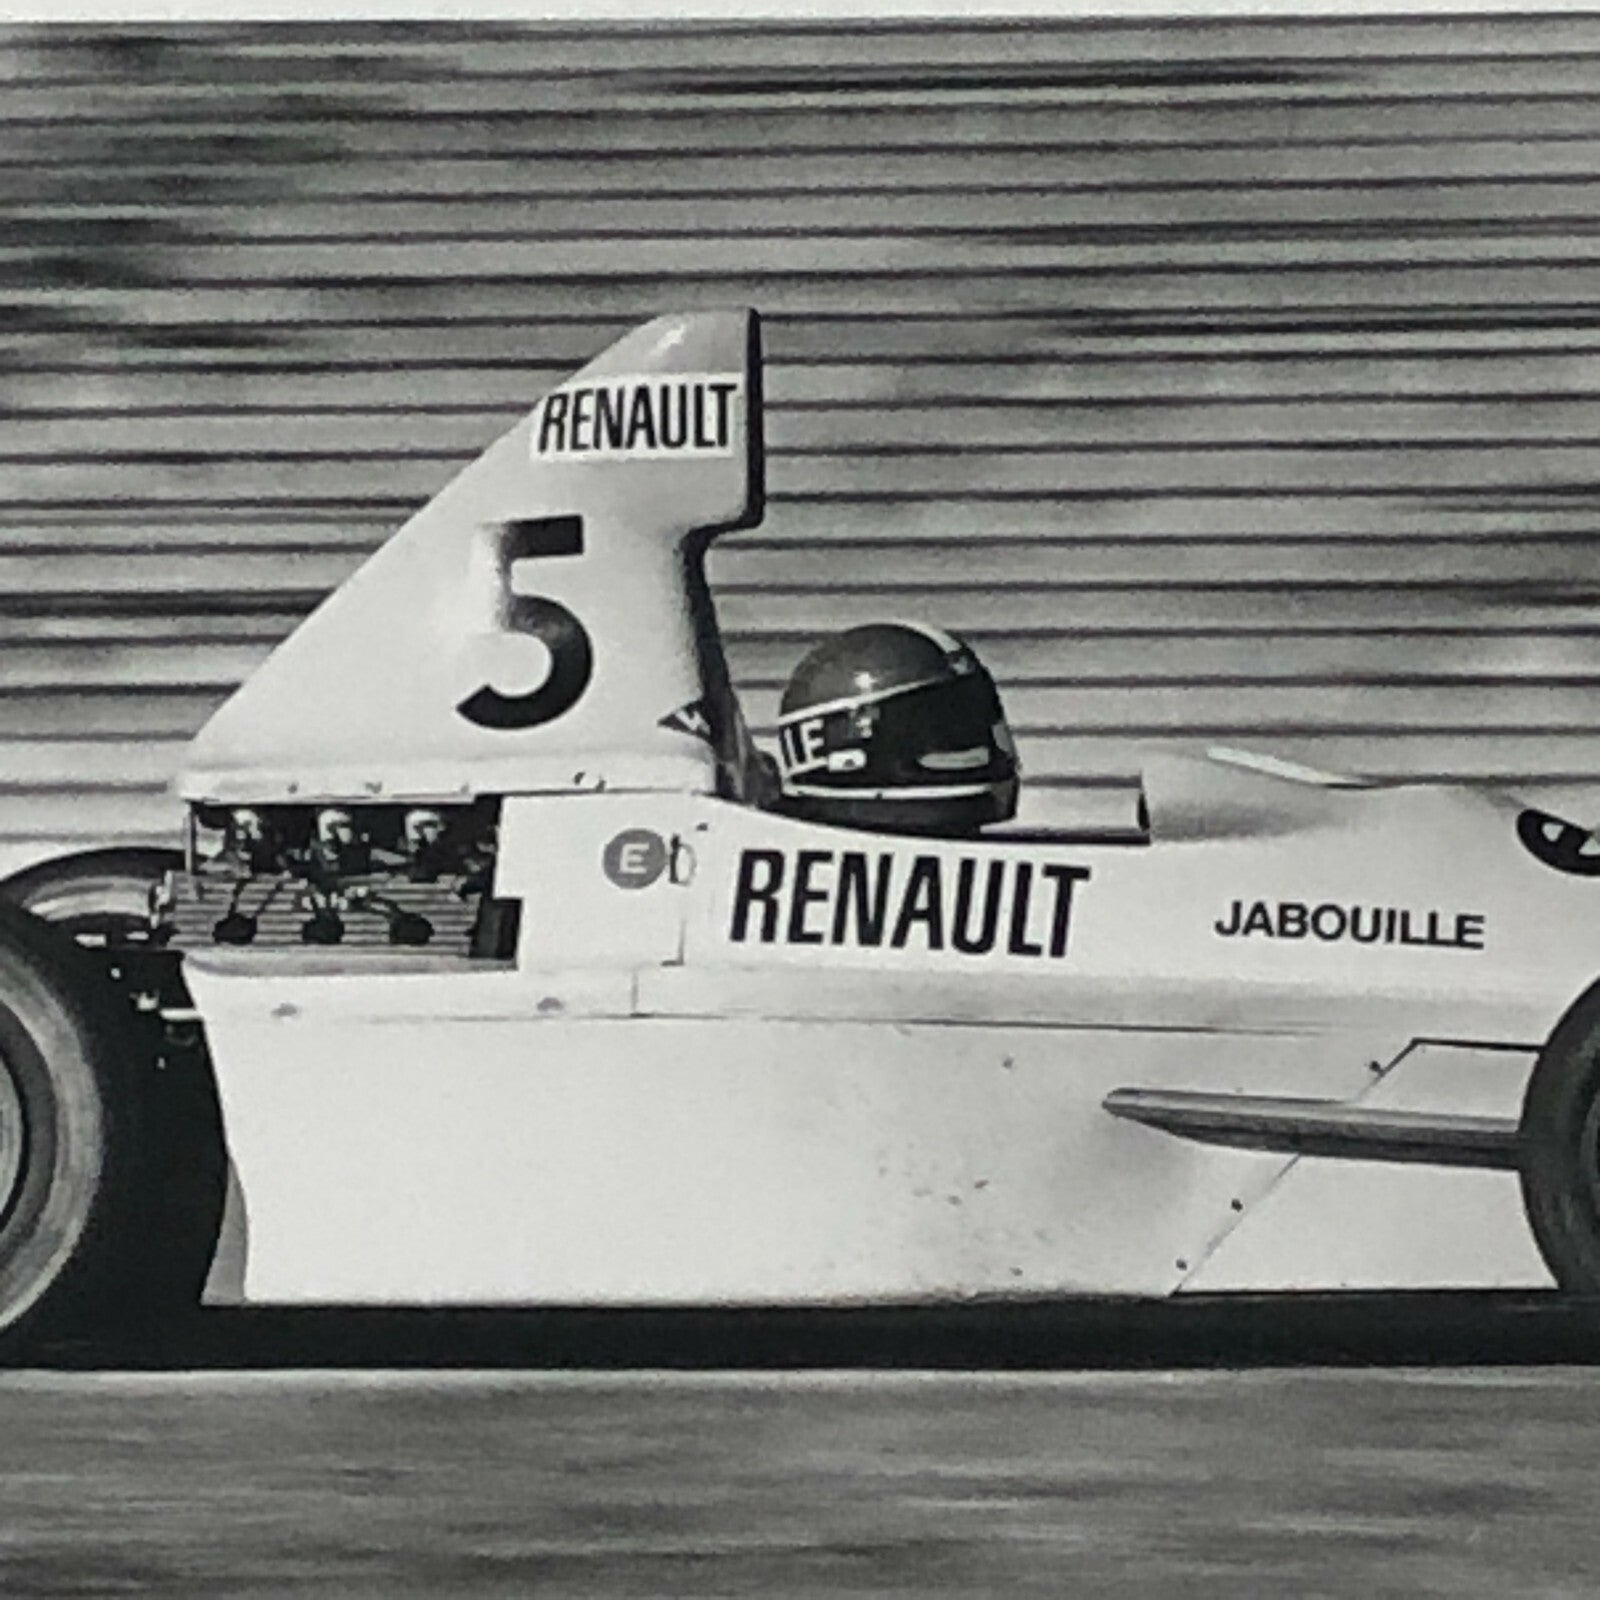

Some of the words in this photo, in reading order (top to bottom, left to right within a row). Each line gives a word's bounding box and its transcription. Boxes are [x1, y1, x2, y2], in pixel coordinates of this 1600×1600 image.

[538, 382, 738, 453] RENAULT
[456, 514, 594, 731] 5
[619, 842, 650, 873] E
[729, 848, 1092, 959] RENAULT
[1214, 900, 1485, 949] JABOUILLE
